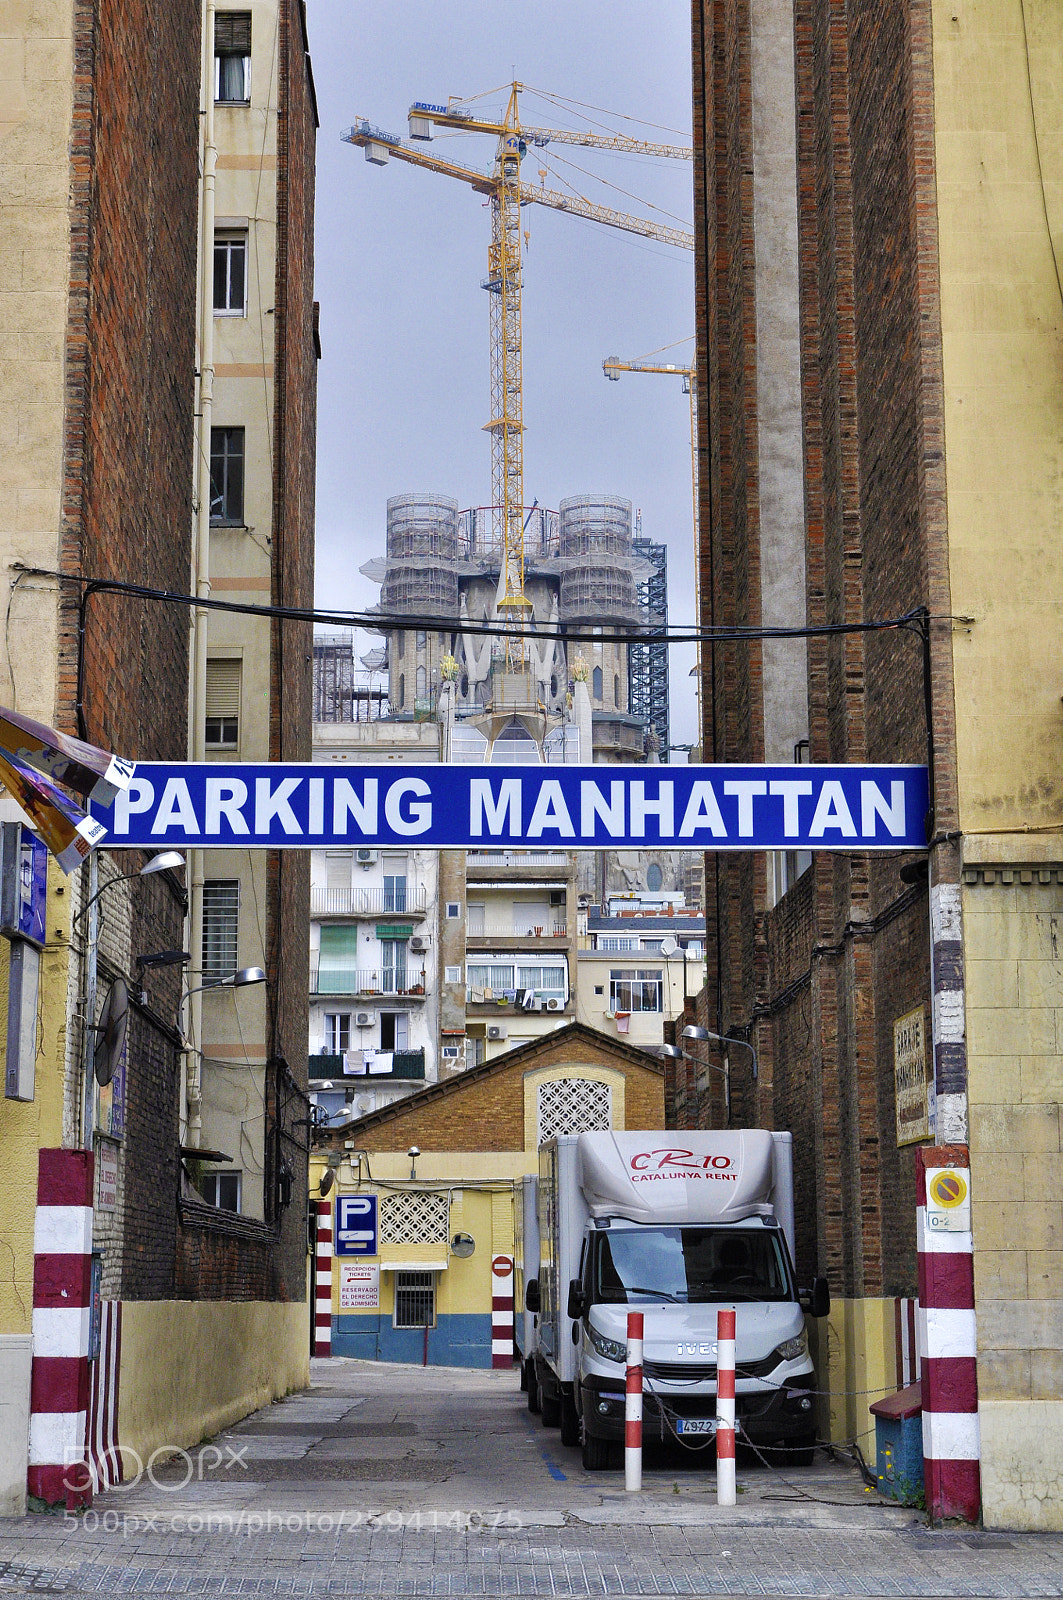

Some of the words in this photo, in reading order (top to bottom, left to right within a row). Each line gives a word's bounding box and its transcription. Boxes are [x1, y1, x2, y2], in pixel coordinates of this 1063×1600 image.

[415, 102, 447, 113] POTAIN
[113, 777, 433, 837] PARKING
[469, 778, 906, 838] MANHATTAN
[631, 1172, 702, 1182] CATALUNYA
[705, 1172, 738, 1182] RENT
[341, 1198, 372, 1229] P
